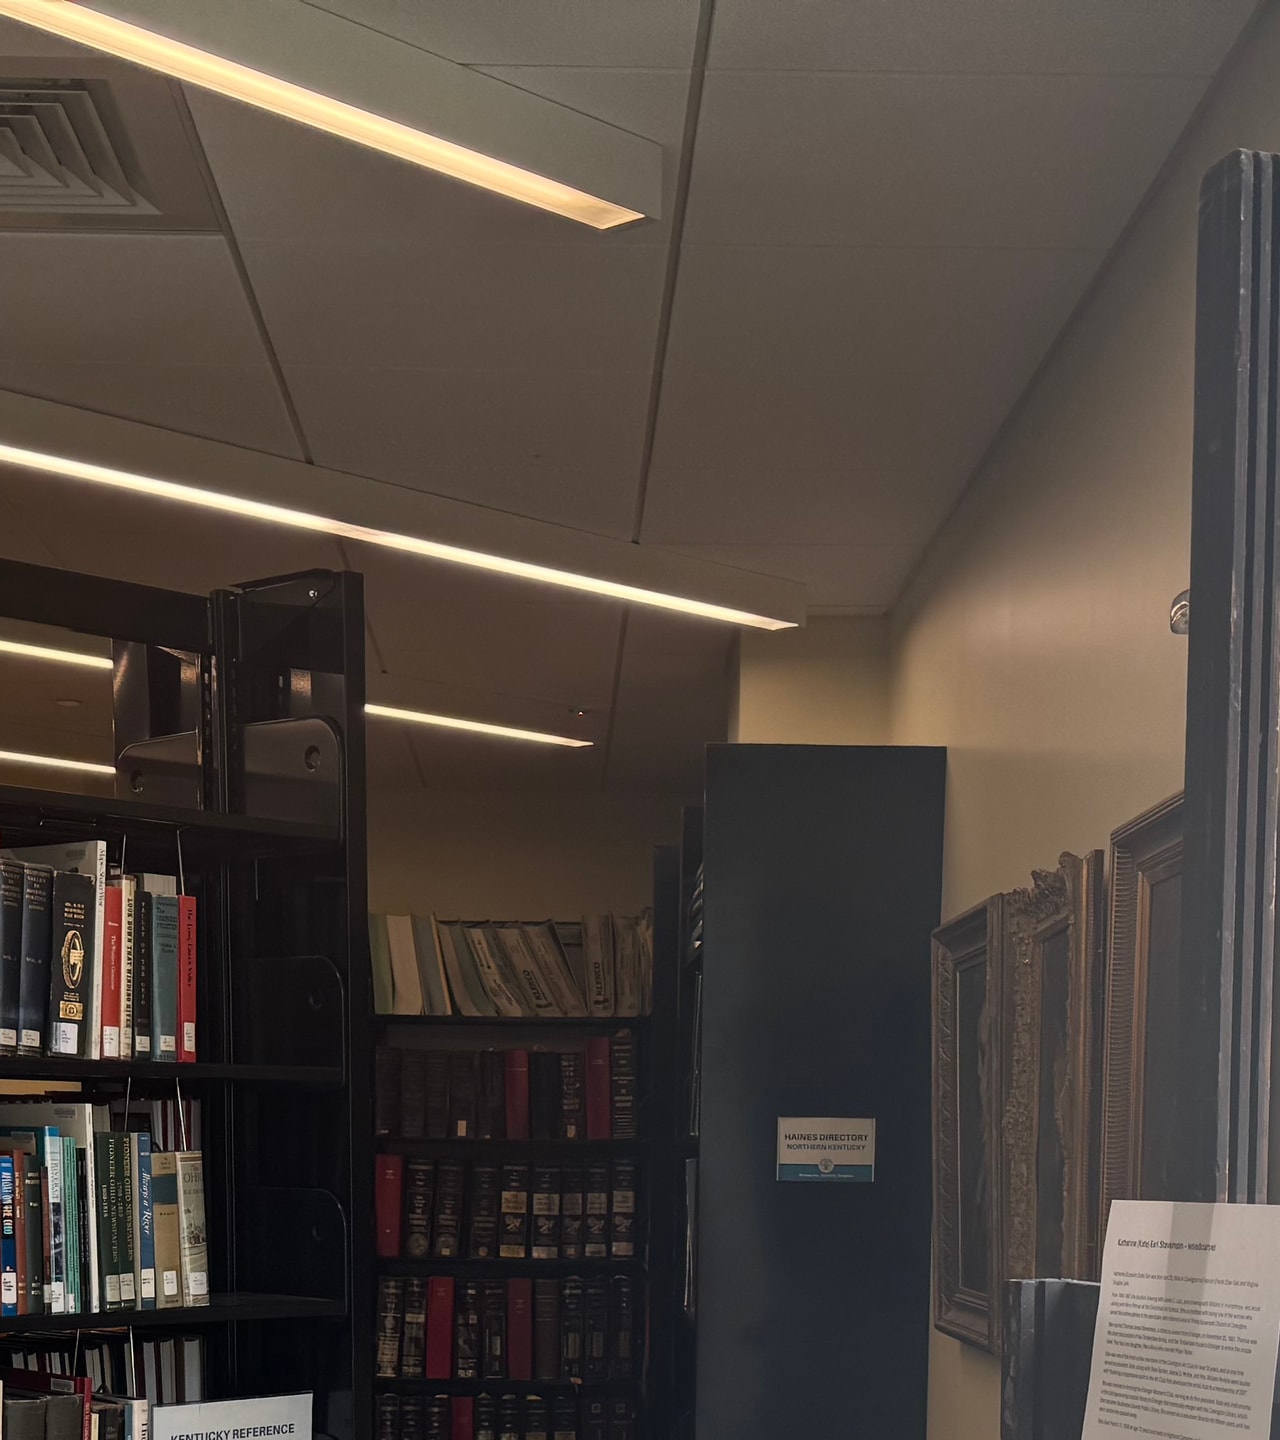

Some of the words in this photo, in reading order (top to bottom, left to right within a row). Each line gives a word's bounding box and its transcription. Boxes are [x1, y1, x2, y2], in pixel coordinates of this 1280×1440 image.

[1, 1172, 12, 1192] AFLOAT
[141, 1168, 150, 1198] Always
[2, 1195, 12, 1204] ON
[2, 1205, 12, 1217] THE
[3, 1219, 13, 1235] OHIO
[125, 1204, 134, 1261] NEWSPAPERS
[142, 1209, 153, 1236] River
[110, 1205, 118, 1262] NEWSPAPERS
[233, 1423, 295, 1439] REFERENCE
